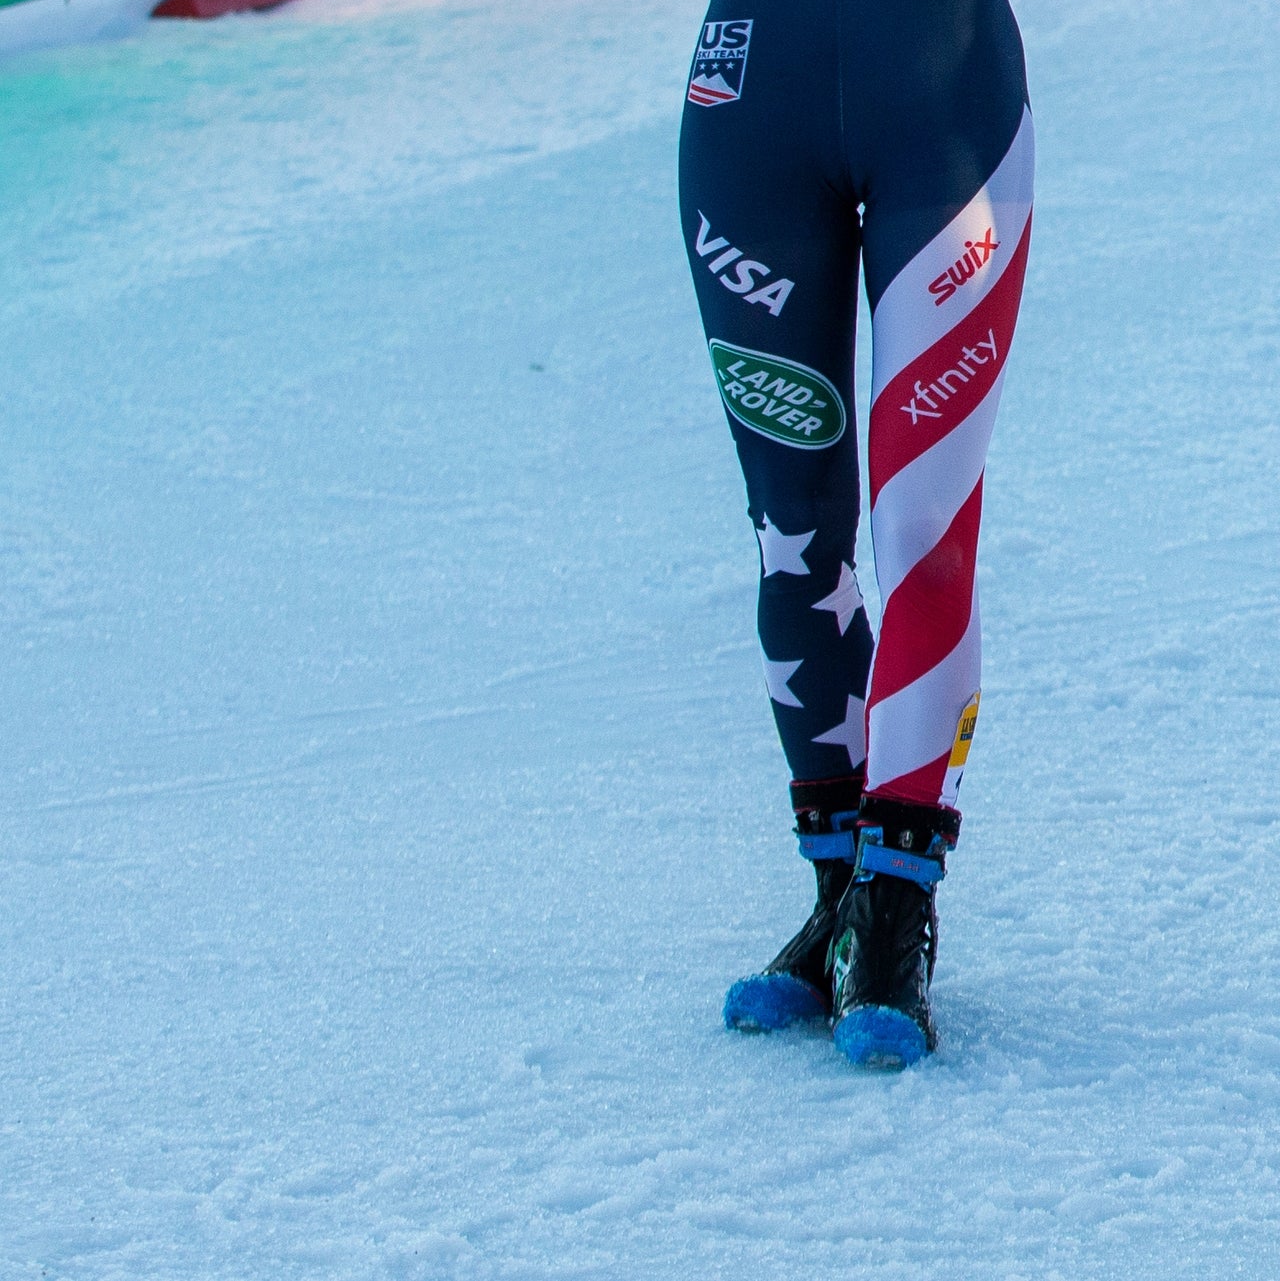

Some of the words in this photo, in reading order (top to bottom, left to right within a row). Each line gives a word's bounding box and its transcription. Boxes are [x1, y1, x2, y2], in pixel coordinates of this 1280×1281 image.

[700, 23, 749, 50] US
[713, 49, 747, 60] TEAM
[695, 209, 796, 317] VISA
[928, 226, 1001, 308] swix
[725, 359, 816, 409] LAND
[899, 328, 1000, 426] xfinity
[724, 381, 823, 437] ROVER
